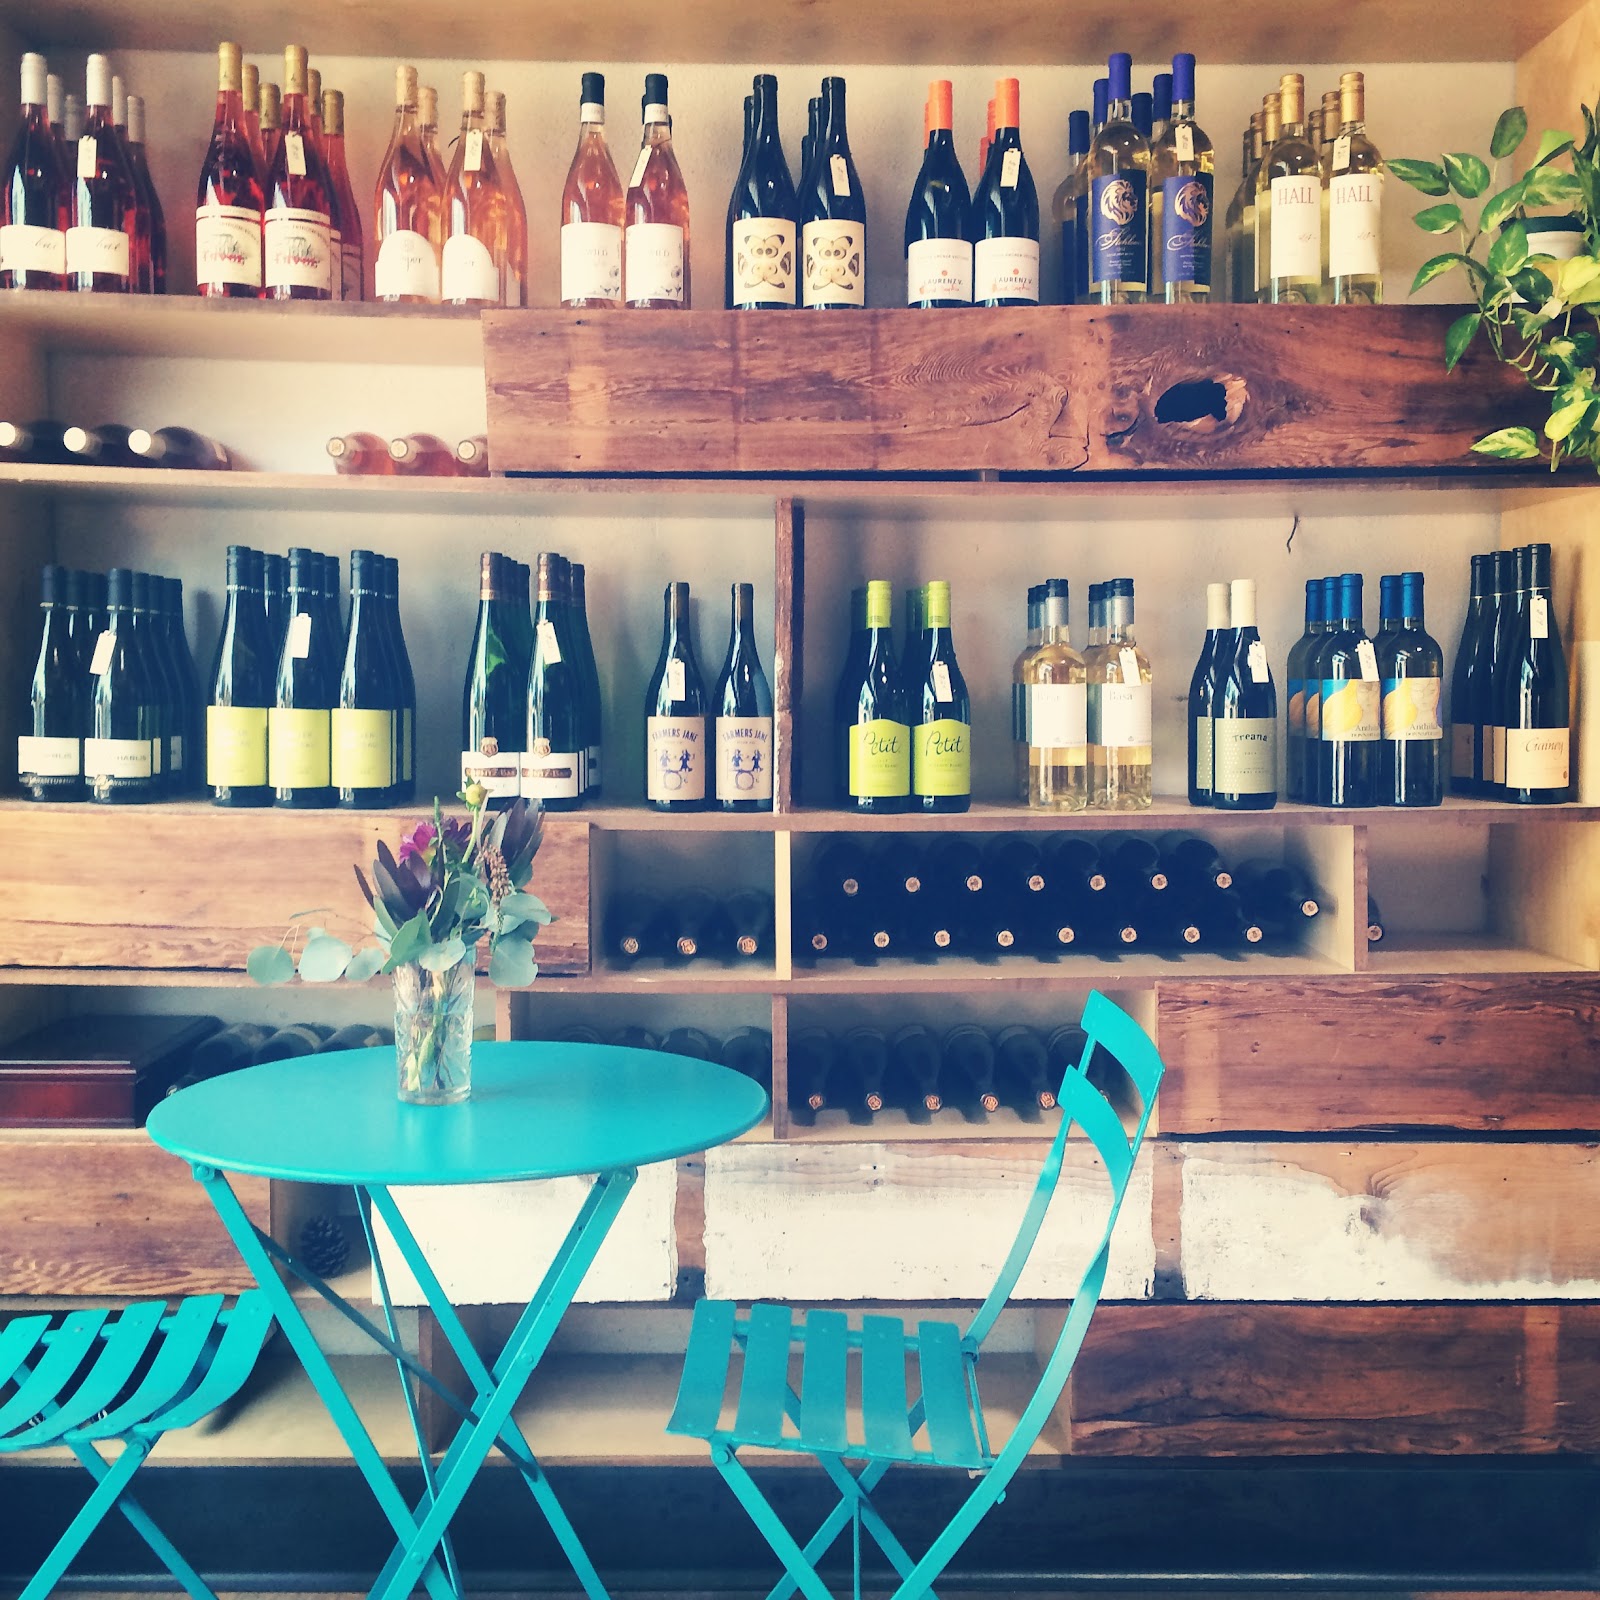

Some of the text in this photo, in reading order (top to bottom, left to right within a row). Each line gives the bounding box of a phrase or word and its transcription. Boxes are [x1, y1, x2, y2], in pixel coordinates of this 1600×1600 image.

[1278, 186, 1314, 205] HALL
[1336, 185, 1373, 204] HALL
[652, 728, 698, 742] FARMERS JANE
[723, 728, 768, 743] FARMERS JANE
[863, 730, 901, 755] Petit
[925, 730, 965, 757] Petit
[1232, 733, 1268, 742] Treana
[1525, 737, 1564, 760] Gainey
